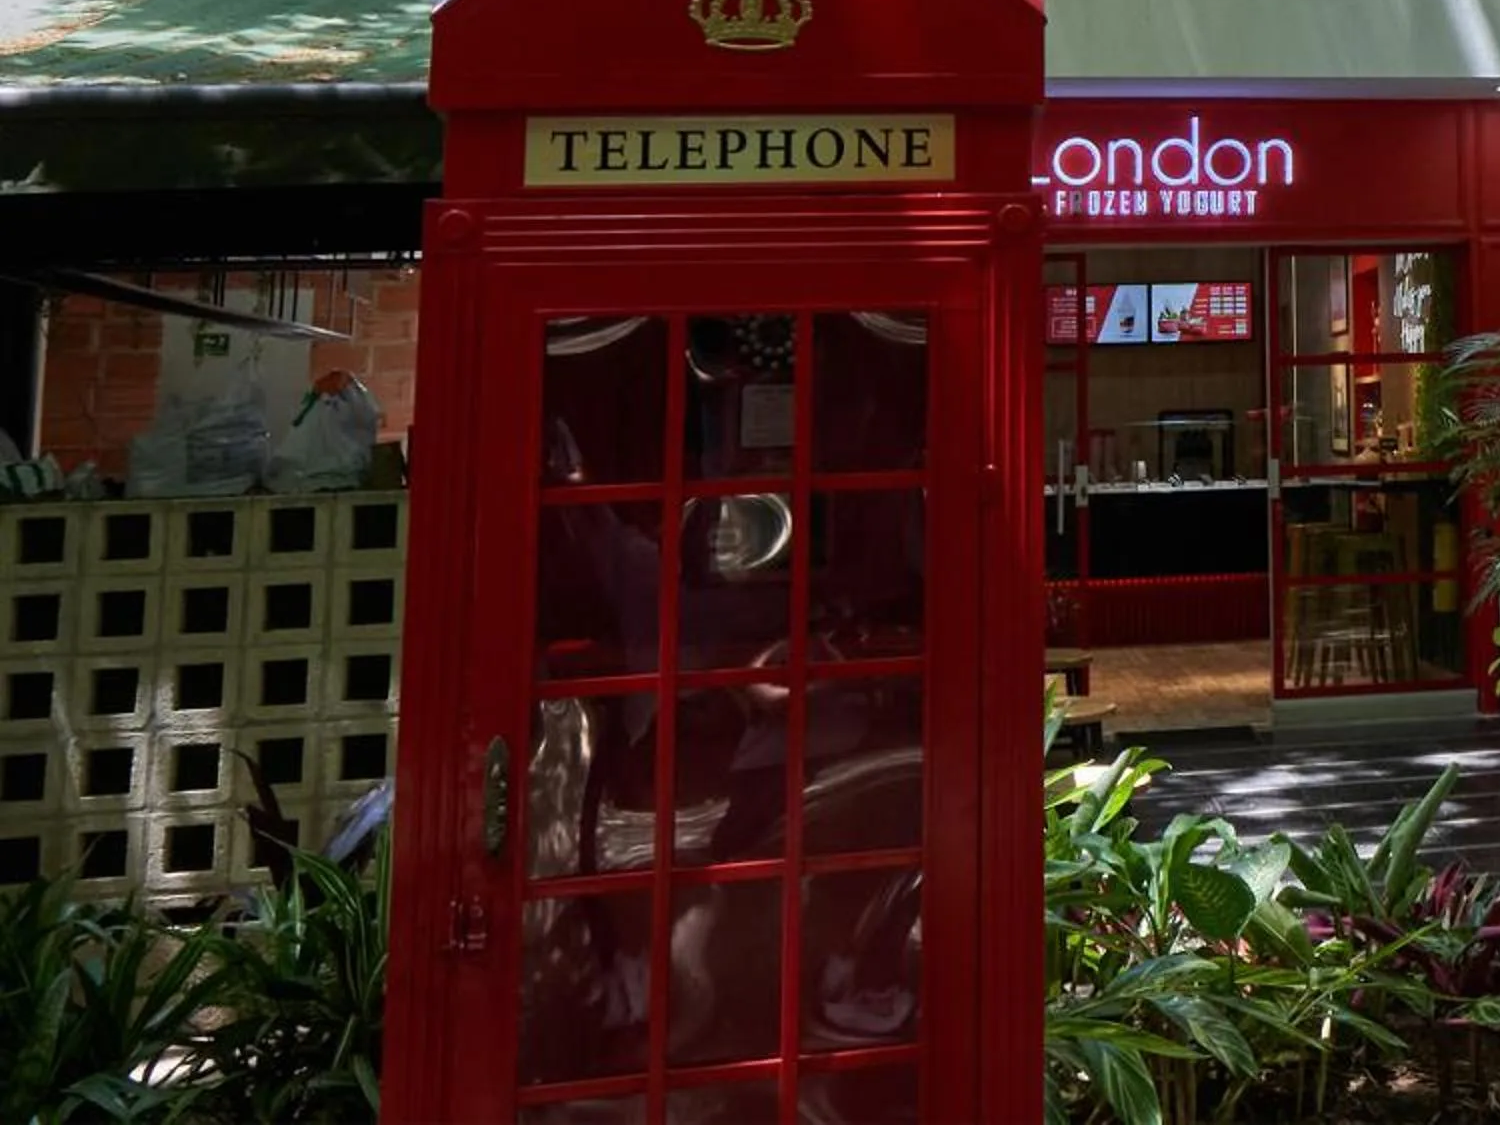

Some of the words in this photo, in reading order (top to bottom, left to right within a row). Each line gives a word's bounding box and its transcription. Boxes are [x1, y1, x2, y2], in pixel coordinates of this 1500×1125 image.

[550, 127, 933, 172] TELEPHONE
[1031, 116, 1294, 186] ondon
[1055, 190, 1148, 216] FROZEN
[1159, 190, 1259, 216] YOGURT
